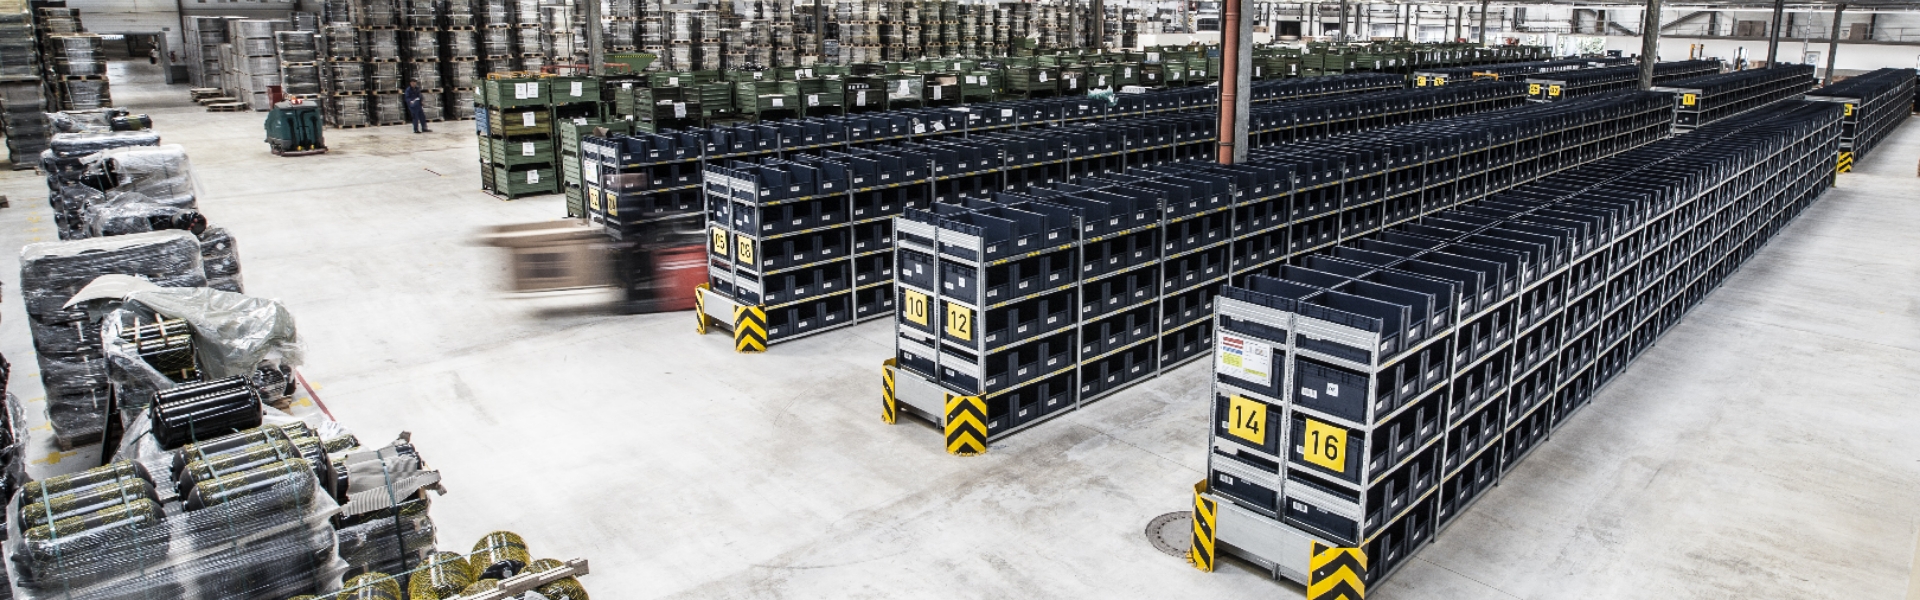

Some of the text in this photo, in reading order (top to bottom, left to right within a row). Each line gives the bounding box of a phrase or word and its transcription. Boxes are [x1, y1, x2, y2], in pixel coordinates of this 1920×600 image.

[740, 241, 751, 258] 08
[908, 296, 923, 318] 10
[951, 310, 967, 334] 12
[1235, 405, 1260, 435] 14
[1311, 429, 1339, 461] 16
